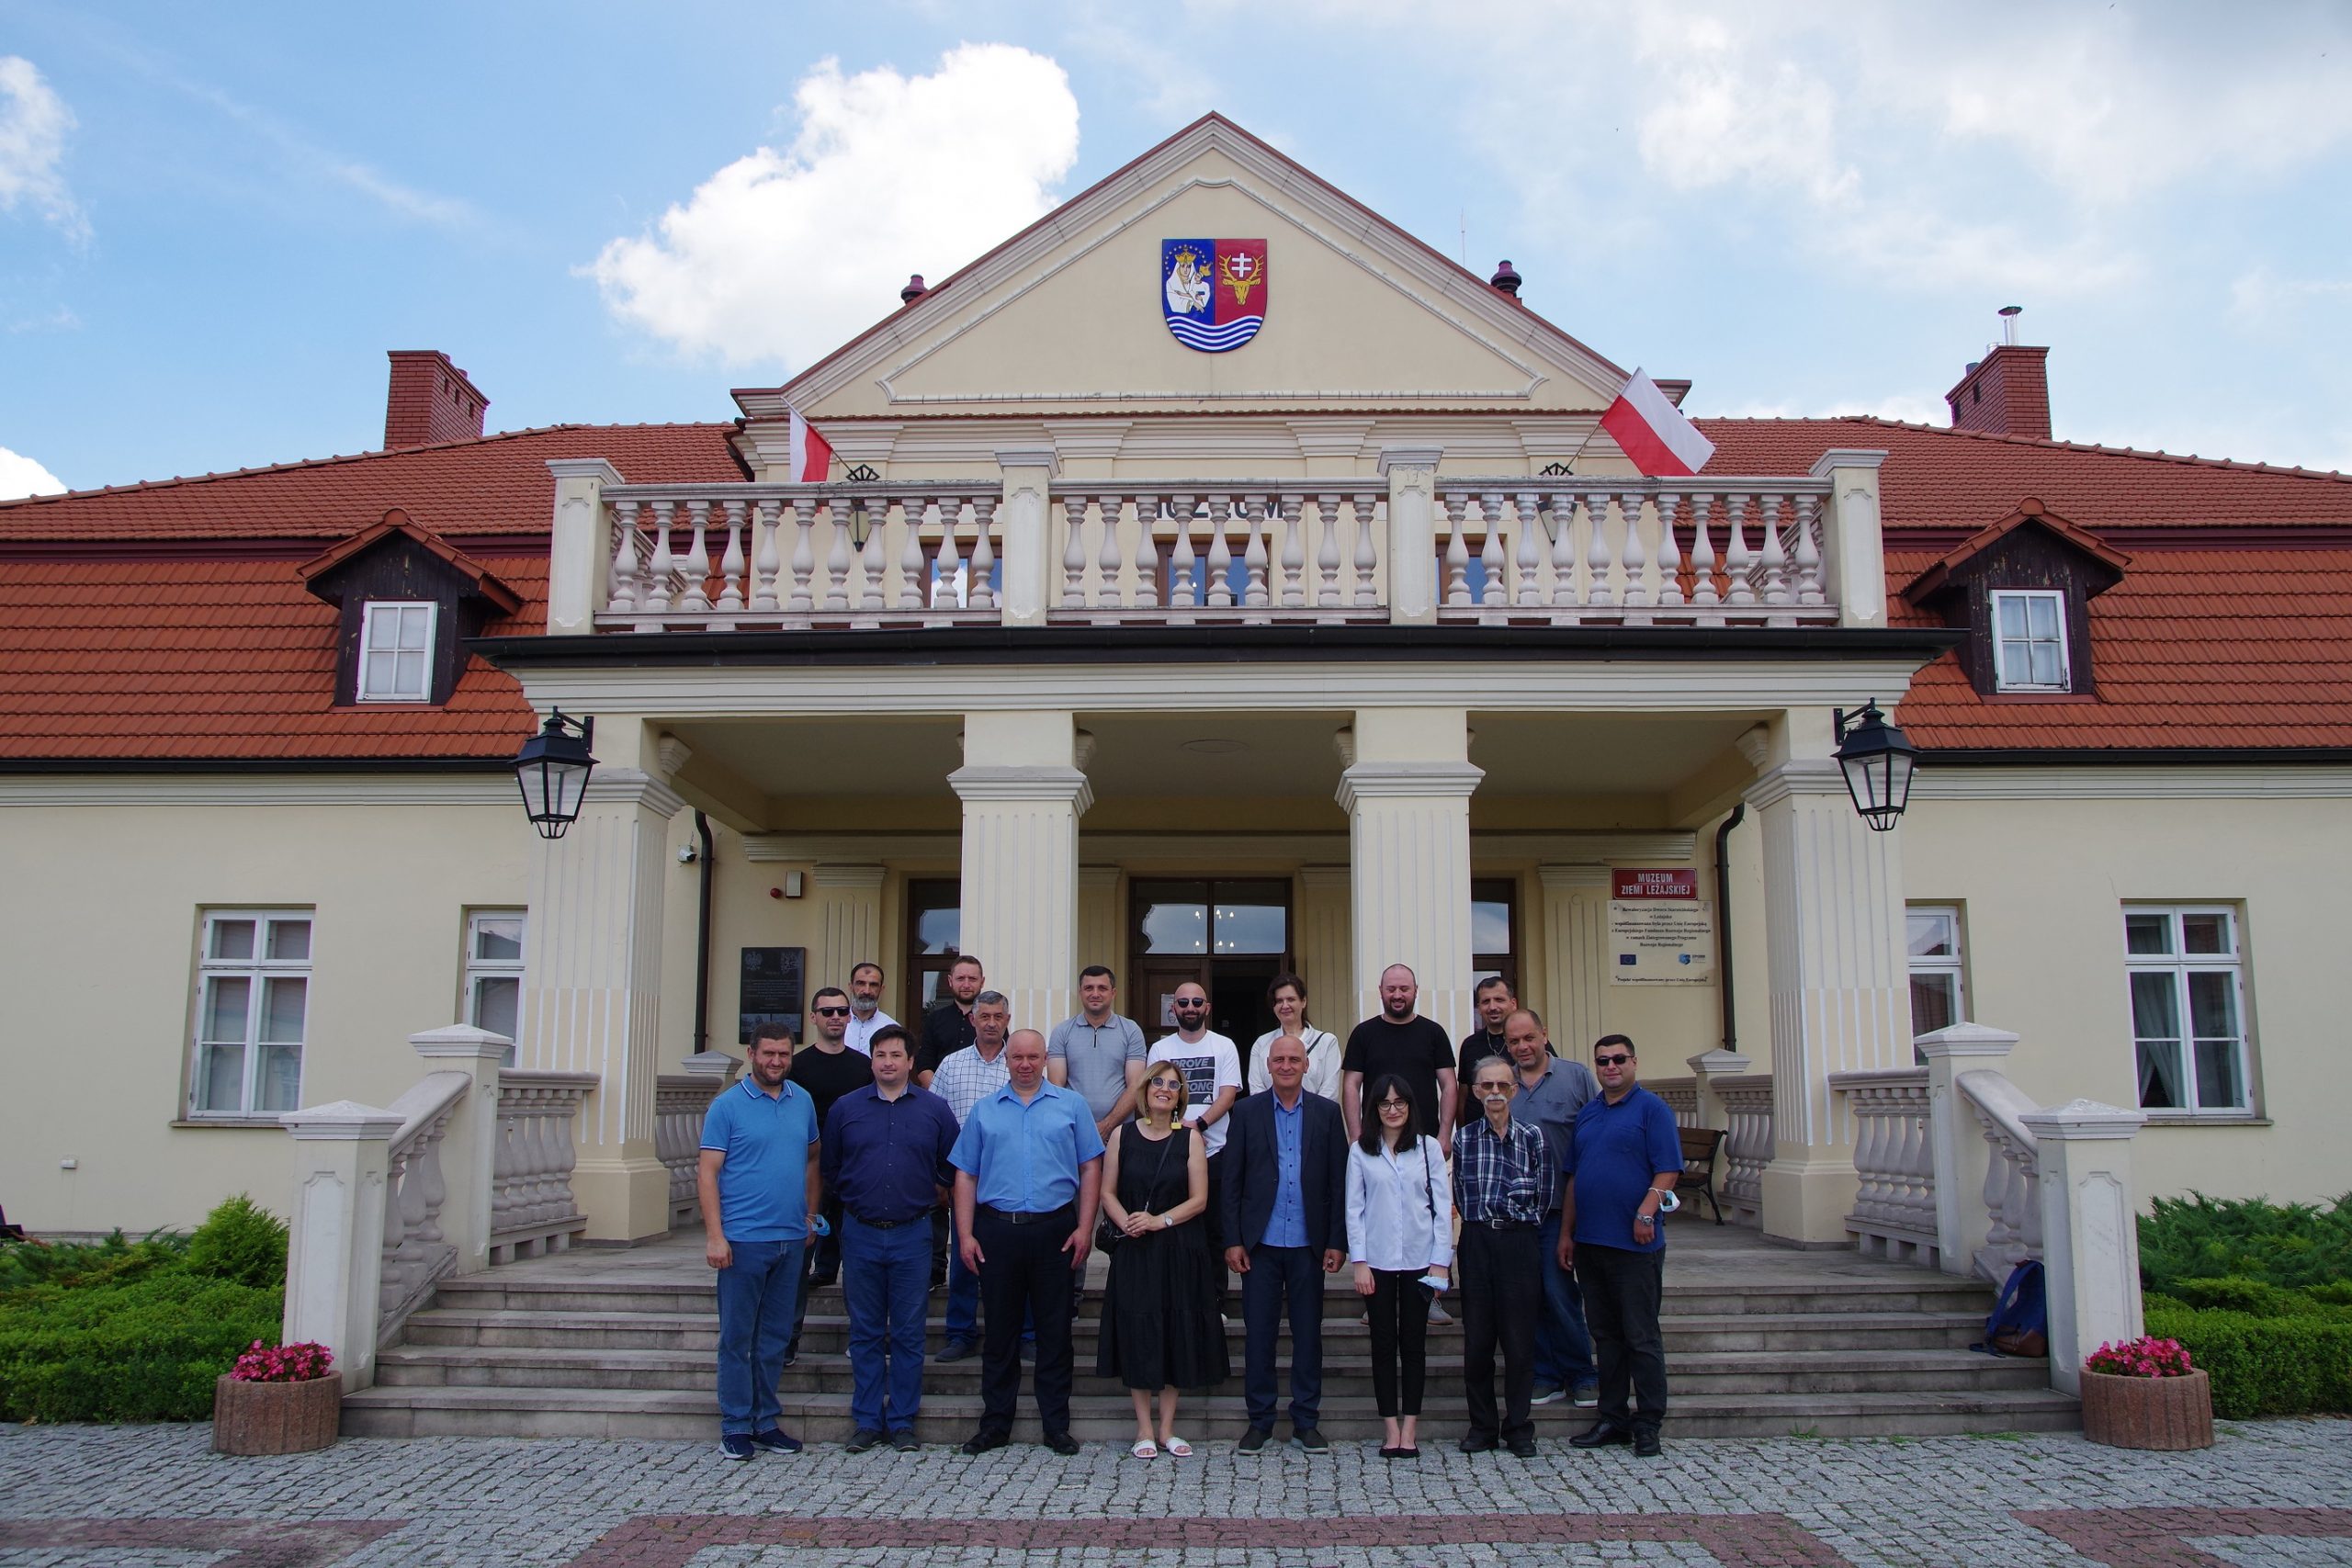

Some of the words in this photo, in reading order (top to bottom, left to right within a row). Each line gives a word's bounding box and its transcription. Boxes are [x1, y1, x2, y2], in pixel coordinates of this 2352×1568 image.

[1637, 873, 1673, 883] MUZEUM
[1621, 885, 1643, 895] ZIEMI
[1646, 883, 1690, 895] LEŻAJSKIEJ
